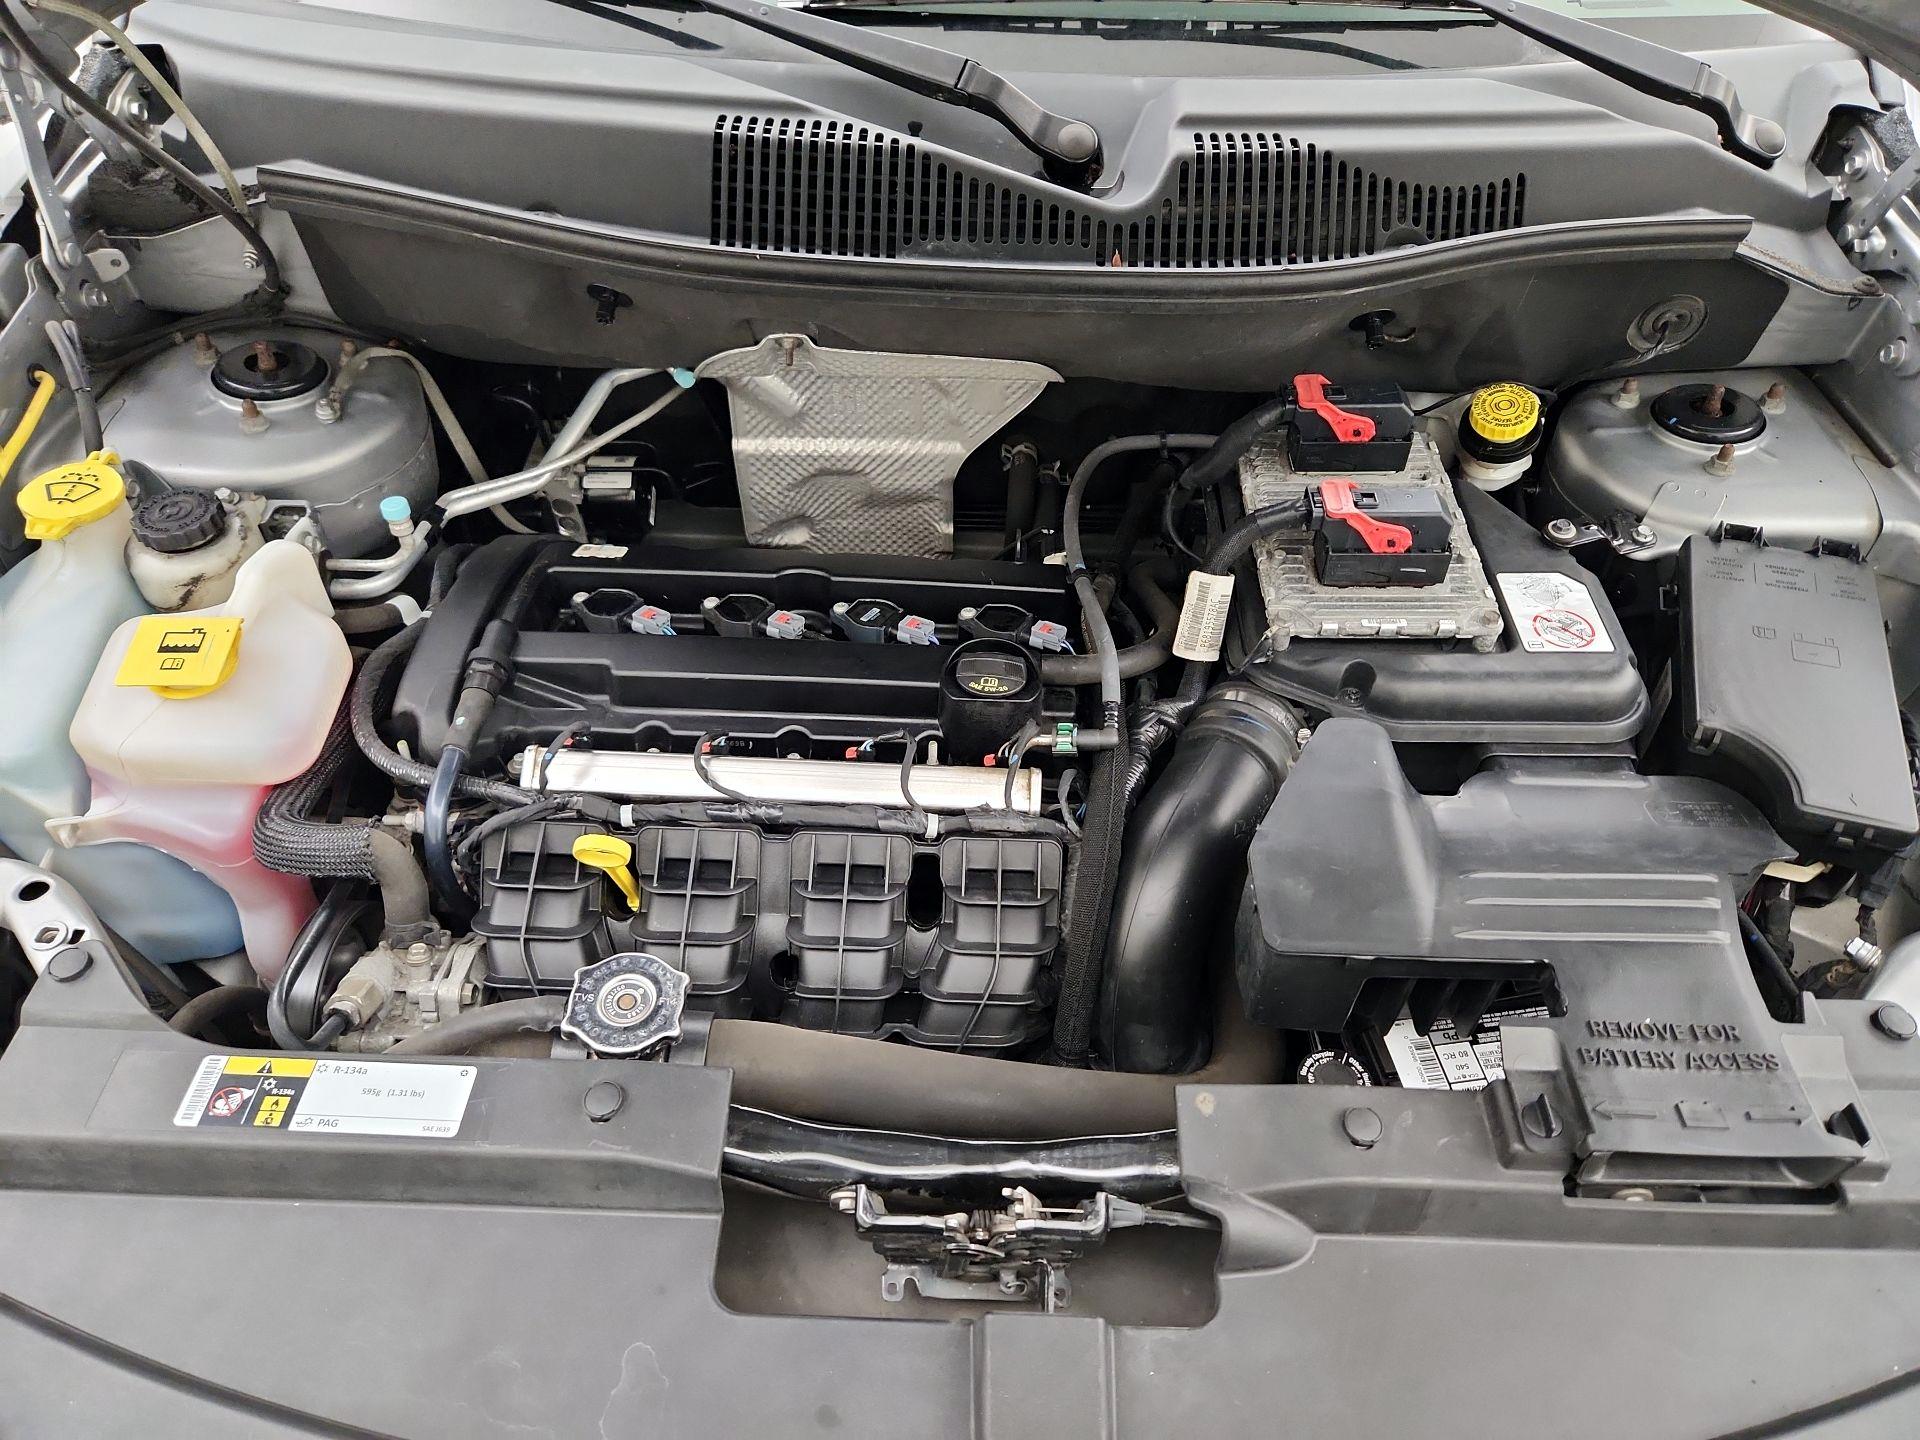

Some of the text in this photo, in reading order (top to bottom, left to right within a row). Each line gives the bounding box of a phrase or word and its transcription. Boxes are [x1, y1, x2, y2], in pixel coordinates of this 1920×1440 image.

[969, 681, 984, 690] SAE
[574, 993, 595, 1002] TVS
[1585, 1018, 1741, 1042] REMOVE FOR
[1443, 1031, 1459, 1042] Pb
[1311, 1050, 1334, 1060] Chrysler
[1442, 1050, 1469, 1060] 80 RC
[1578, 1046, 1782, 1072] BATTERY ACCESS
[332, 1066, 368, 1076] R-134a
[272, 1086, 295, 1096] R-134a
[362, 1088, 425, 1099] 595g (1.31 lbs)
[317, 1118, 340, 1128] PAG
[421, 1124, 434, 1132] SAE
